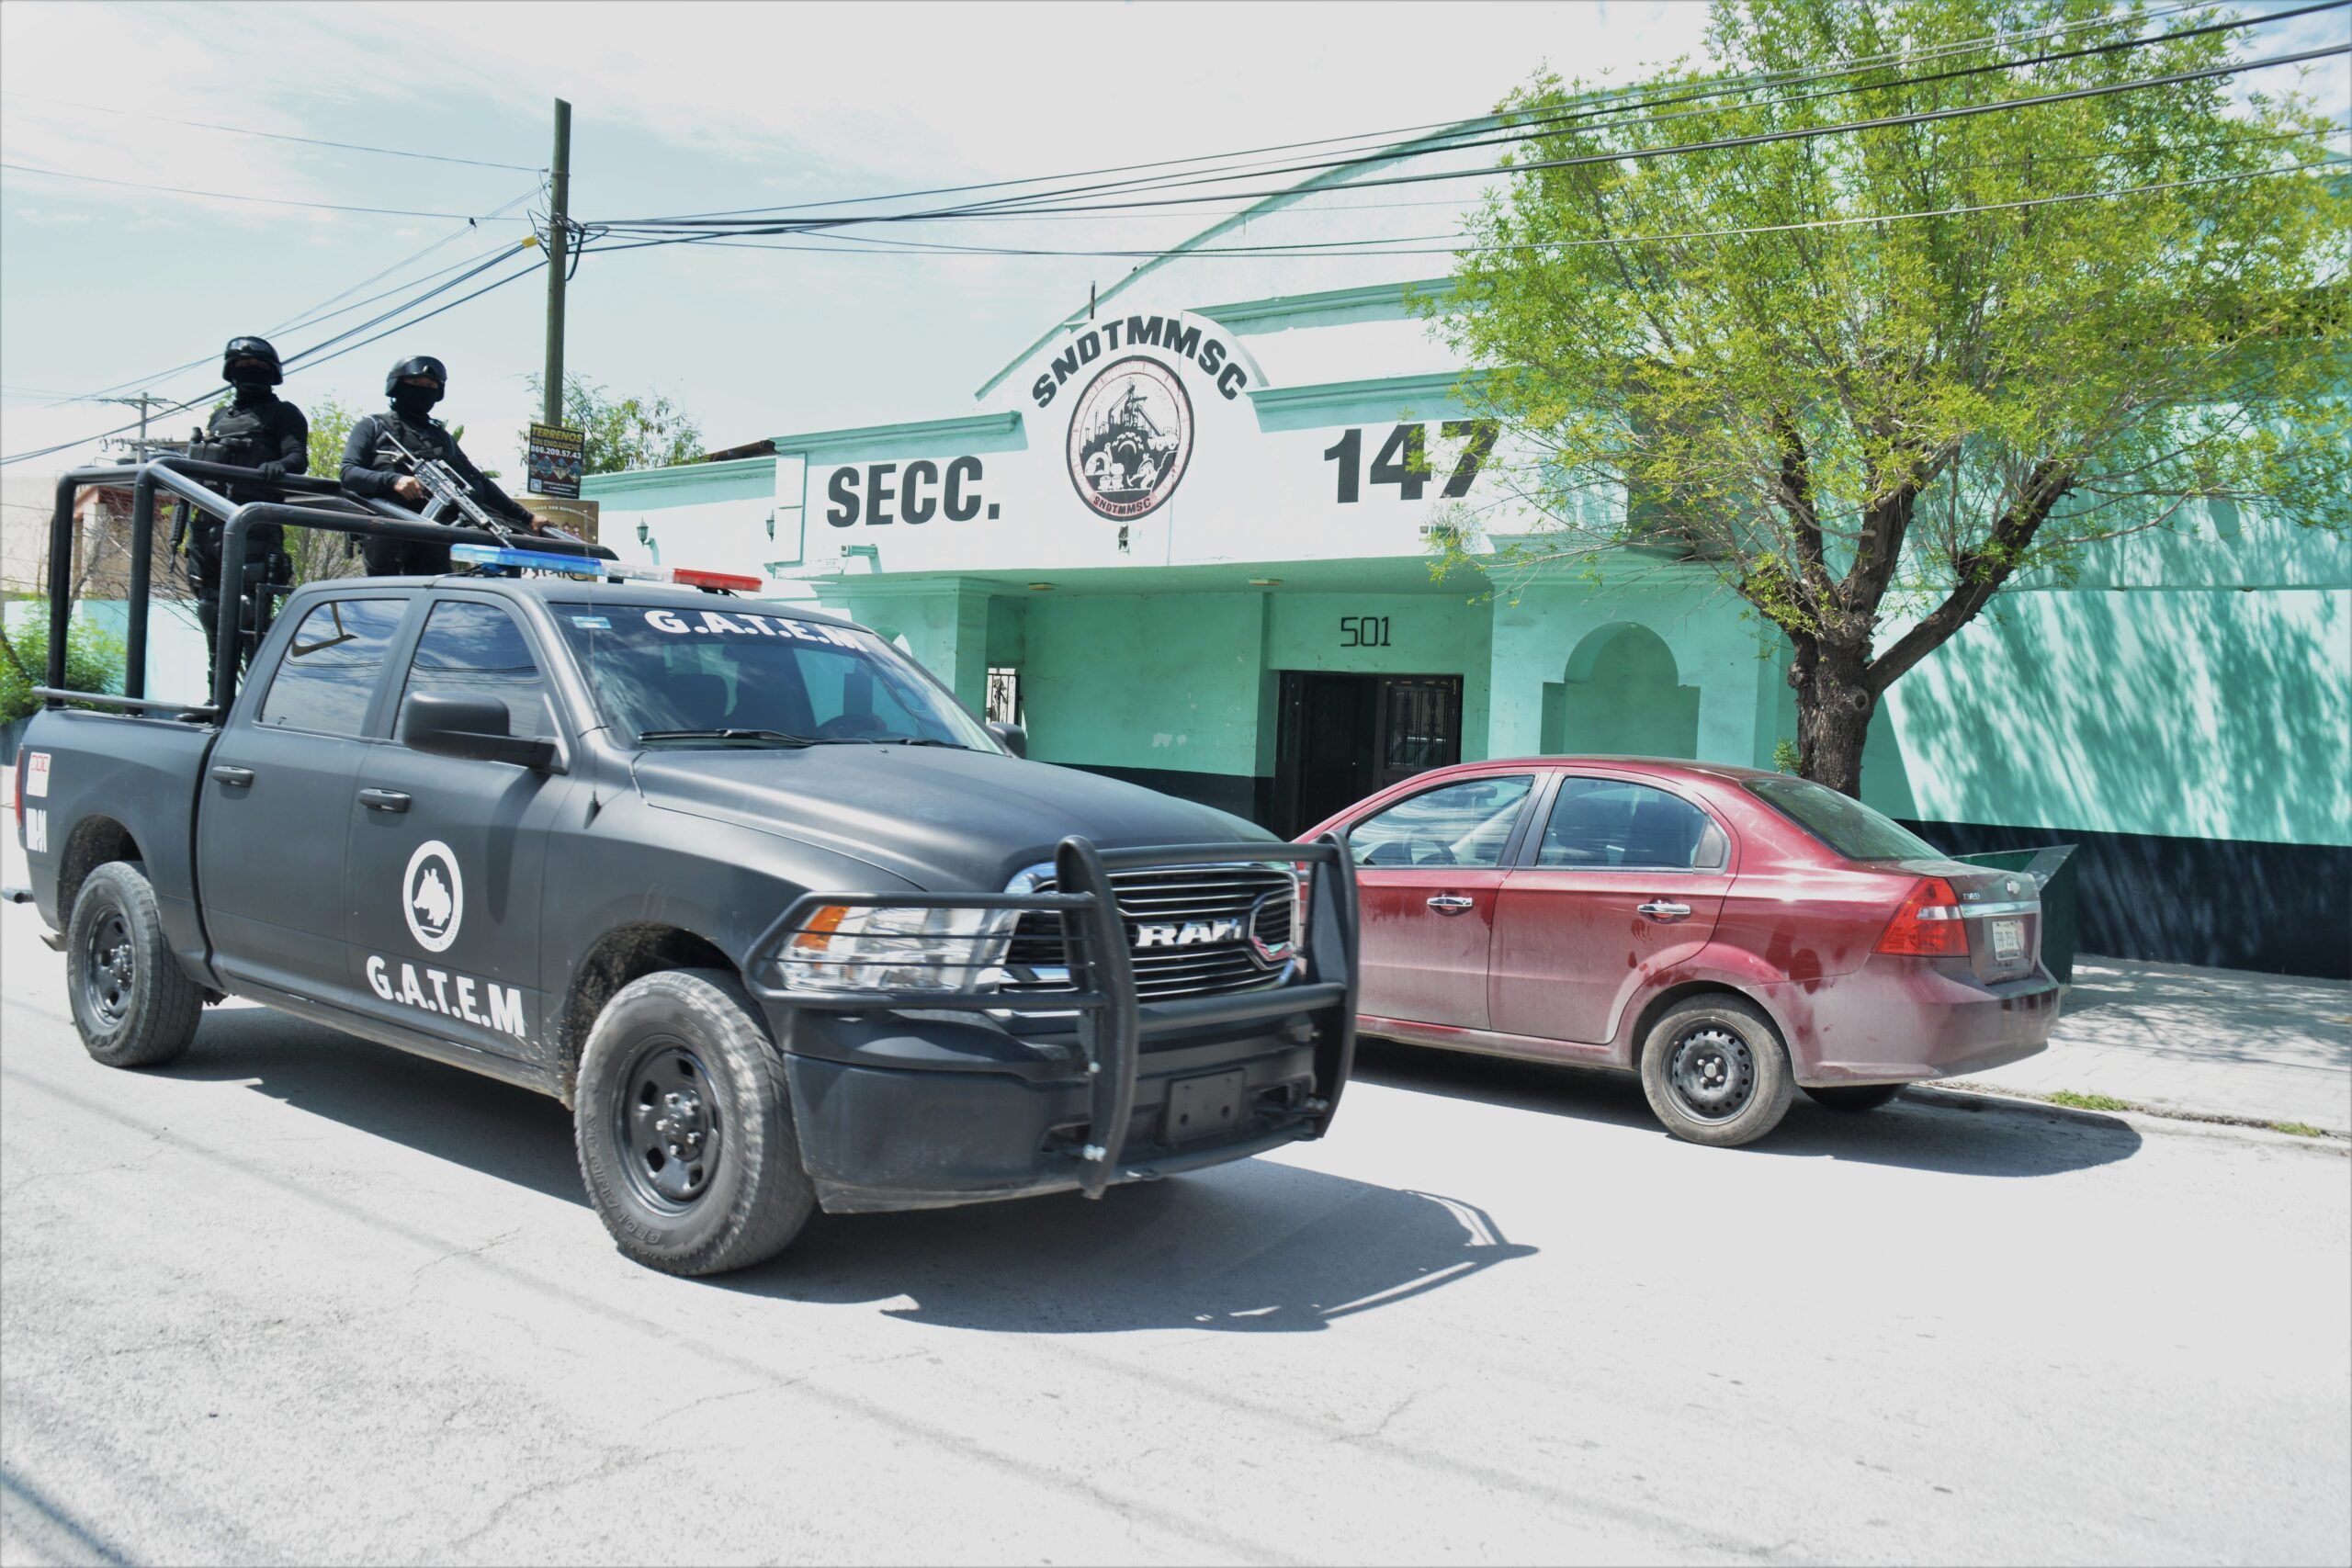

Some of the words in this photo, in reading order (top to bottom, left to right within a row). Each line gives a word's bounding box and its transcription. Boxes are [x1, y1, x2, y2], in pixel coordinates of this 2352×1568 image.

[1032, 315, 1248, 409] SNDTMMSC
[530, 445, 582, 459] 866.209.57.43
[531, 426, 583, 444] TERRENOS
[1324, 419, 1500, 504] 147
[827, 455, 1001, 528] SECC.
[1092, 495, 1152, 515] SNDTMMSC
[644, 610, 869, 653] G.A.T.E.M
[1340, 616, 1391, 647] 501
[1136, 919, 1242, 947] RAM
[366, 955, 526, 1038] G.A.T.E.M
